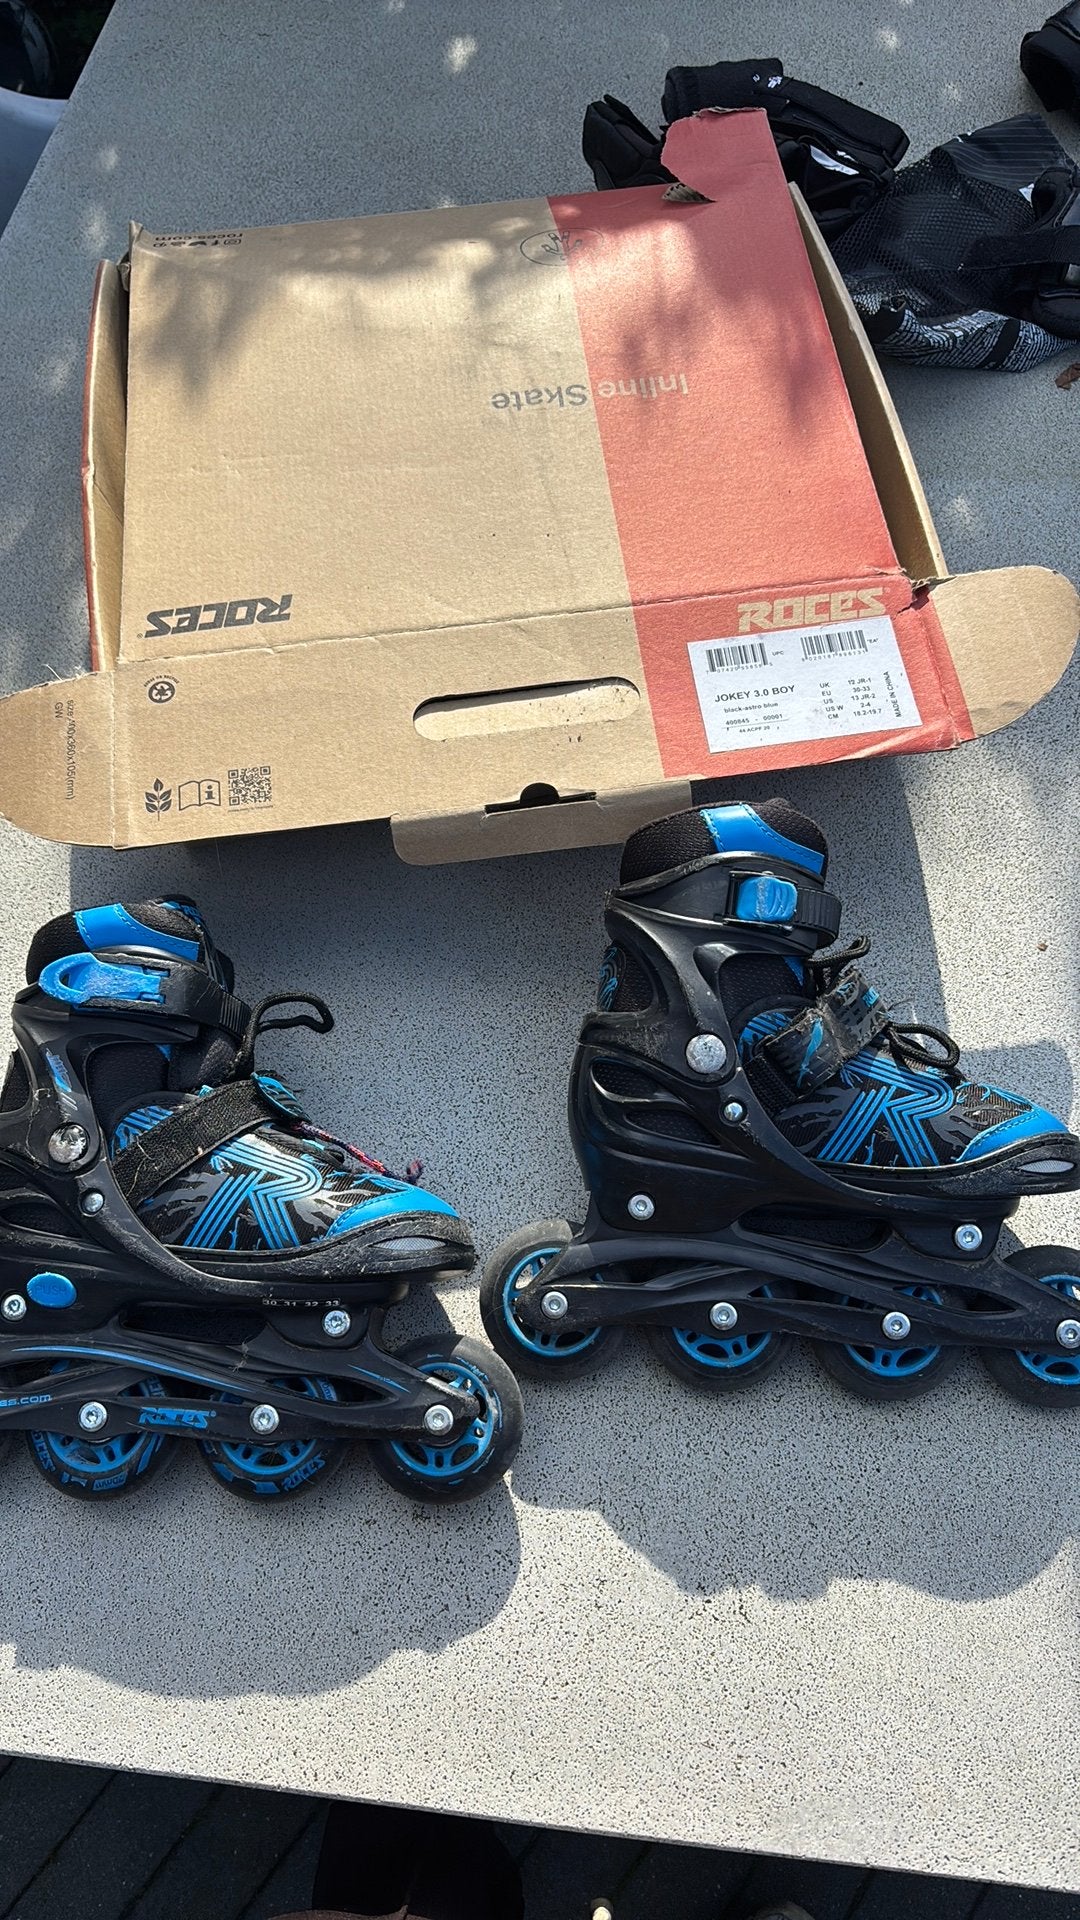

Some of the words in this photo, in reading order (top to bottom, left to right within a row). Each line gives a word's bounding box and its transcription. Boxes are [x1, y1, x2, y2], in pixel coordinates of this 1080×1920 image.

[155, 233, 243, 241] roces.com
[598, 373, 689, 399] Inline
[491, 384, 588, 411] Skate
[144, 594, 293, 638] ROCES
[737, 587, 887, 633] ROCES
[883, 671, 894, 691] CHINA
[715, 690, 751, 703] JOKEY
[754, 688, 769, 697] 3.0
[772, 685, 795, 695] BOY
[55, 702, 63, 718] GW
[724, 704, 762, 713] black-astro
[891, 699, 902, 717] MADE
[35, 1283, 67, 1296] PUSH
[138, 1406, 211, 1429] ROCES
[282, 1455, 326, 1491] ROCES
